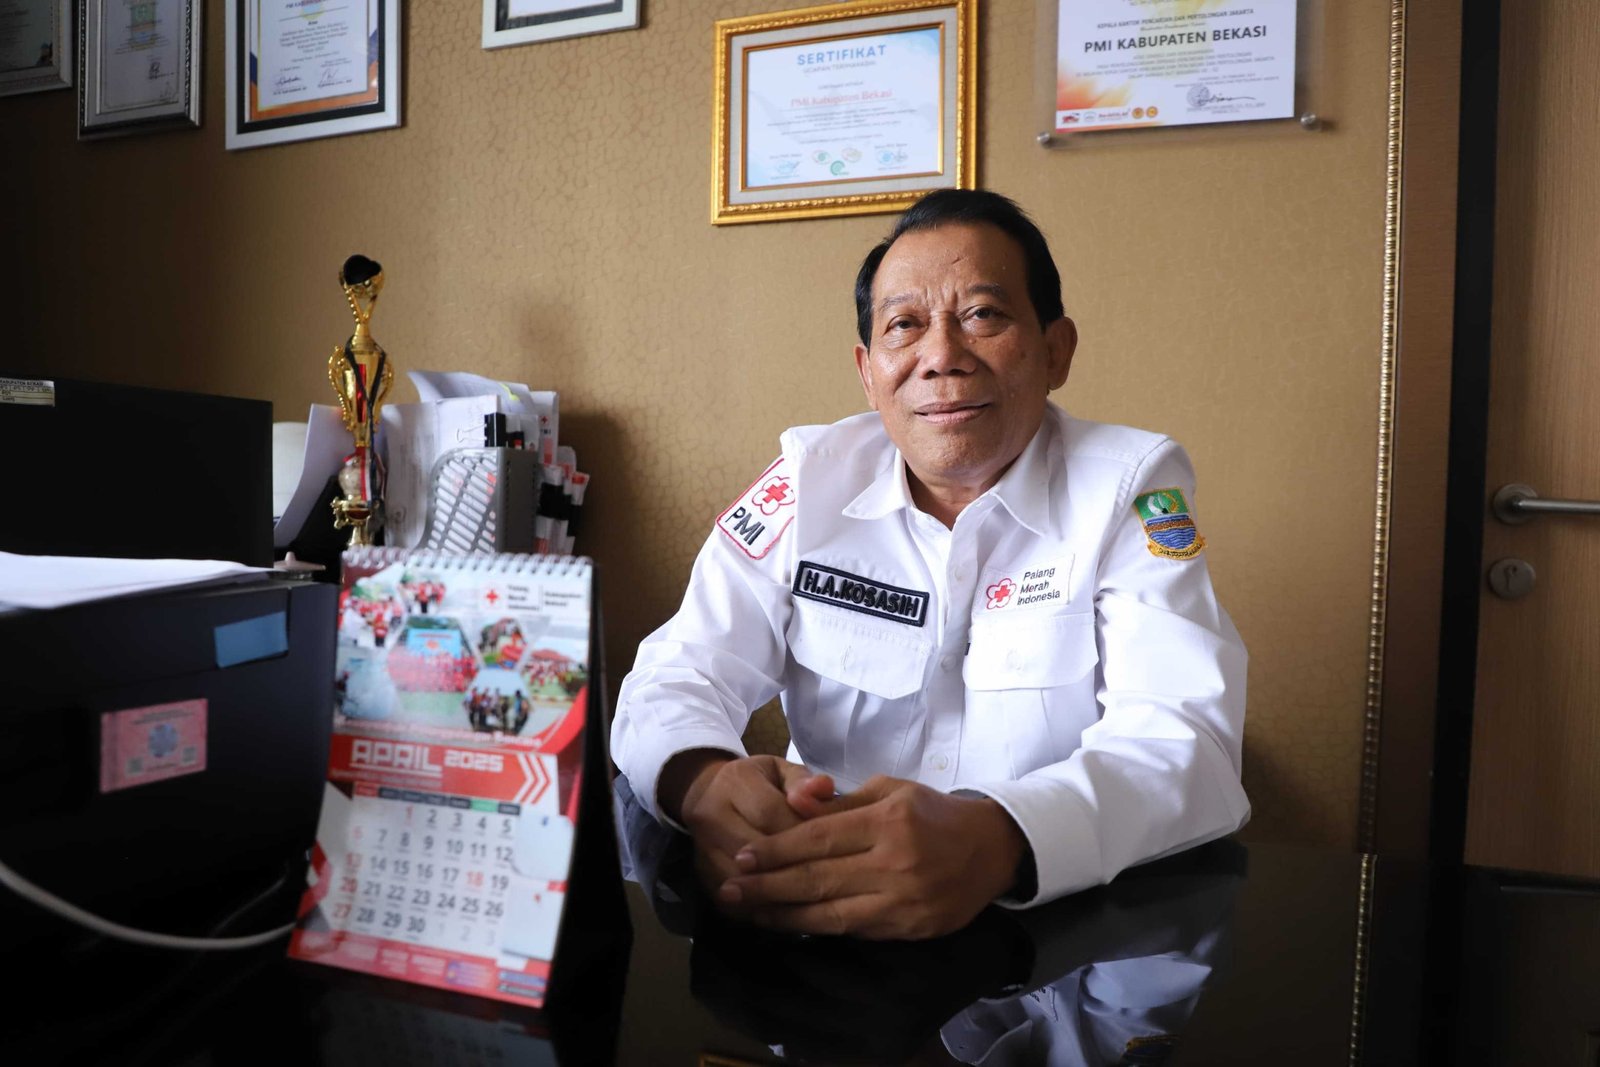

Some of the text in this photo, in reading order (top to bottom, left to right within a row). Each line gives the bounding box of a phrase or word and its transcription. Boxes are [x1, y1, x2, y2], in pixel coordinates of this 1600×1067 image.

[797, 44, 887, 66] SERTIFIKAT
[1084, 40, 1112, 53] PMI
[1117, 31, 1206, 50] KABUPATEN
[1212, 25, 1267, 41] BEKASI
[725, 506, 766, 546] PMI
[1020, 580, 1050, 594] Merah
[1023, 567, 1056, 582] Palang
[803, 569, 920, 618] H.A.KOSASIH
[1017, 589, 1061, 606] Indonesia
[352, 739, 504, 773] APRIL 2025
[427, 809, 438, 825] 2
[453, 812, 463, 828] 3
[477, 816, 487, 830] 4
[502, 819, 512, 834] 5
[378, 829, 388, 843] 7
[400, 832, 411, 848] 8
[423, 835, 434, 851] 9
[446, 839, 464, 855] 10
[470, 843, 487, 858] 11
[495, 846, 514, 861] 12
[370, 855, 387, 871] 14
[393, 860, 410, 876] 15
[417, 863, 434, 879] 16
[442, 867, 460, 883] 17
[465, 871, 485, 887] 18
[491, 874, 510, 891] 19
[362, 880, 382, 897] 21
[386, 884, 406, 901] 22
[411, 889, 431, 906] 23
[436, 893, 457, 909] 24
[461, 897, 480, 914] 25
[484, 901, 505, 918] 26
[332, 902, 353, 919] 27
[356, 907, 376, 924] 28
[382, 911, 403, 929] 29
[406, 915, 426, 934] 30
